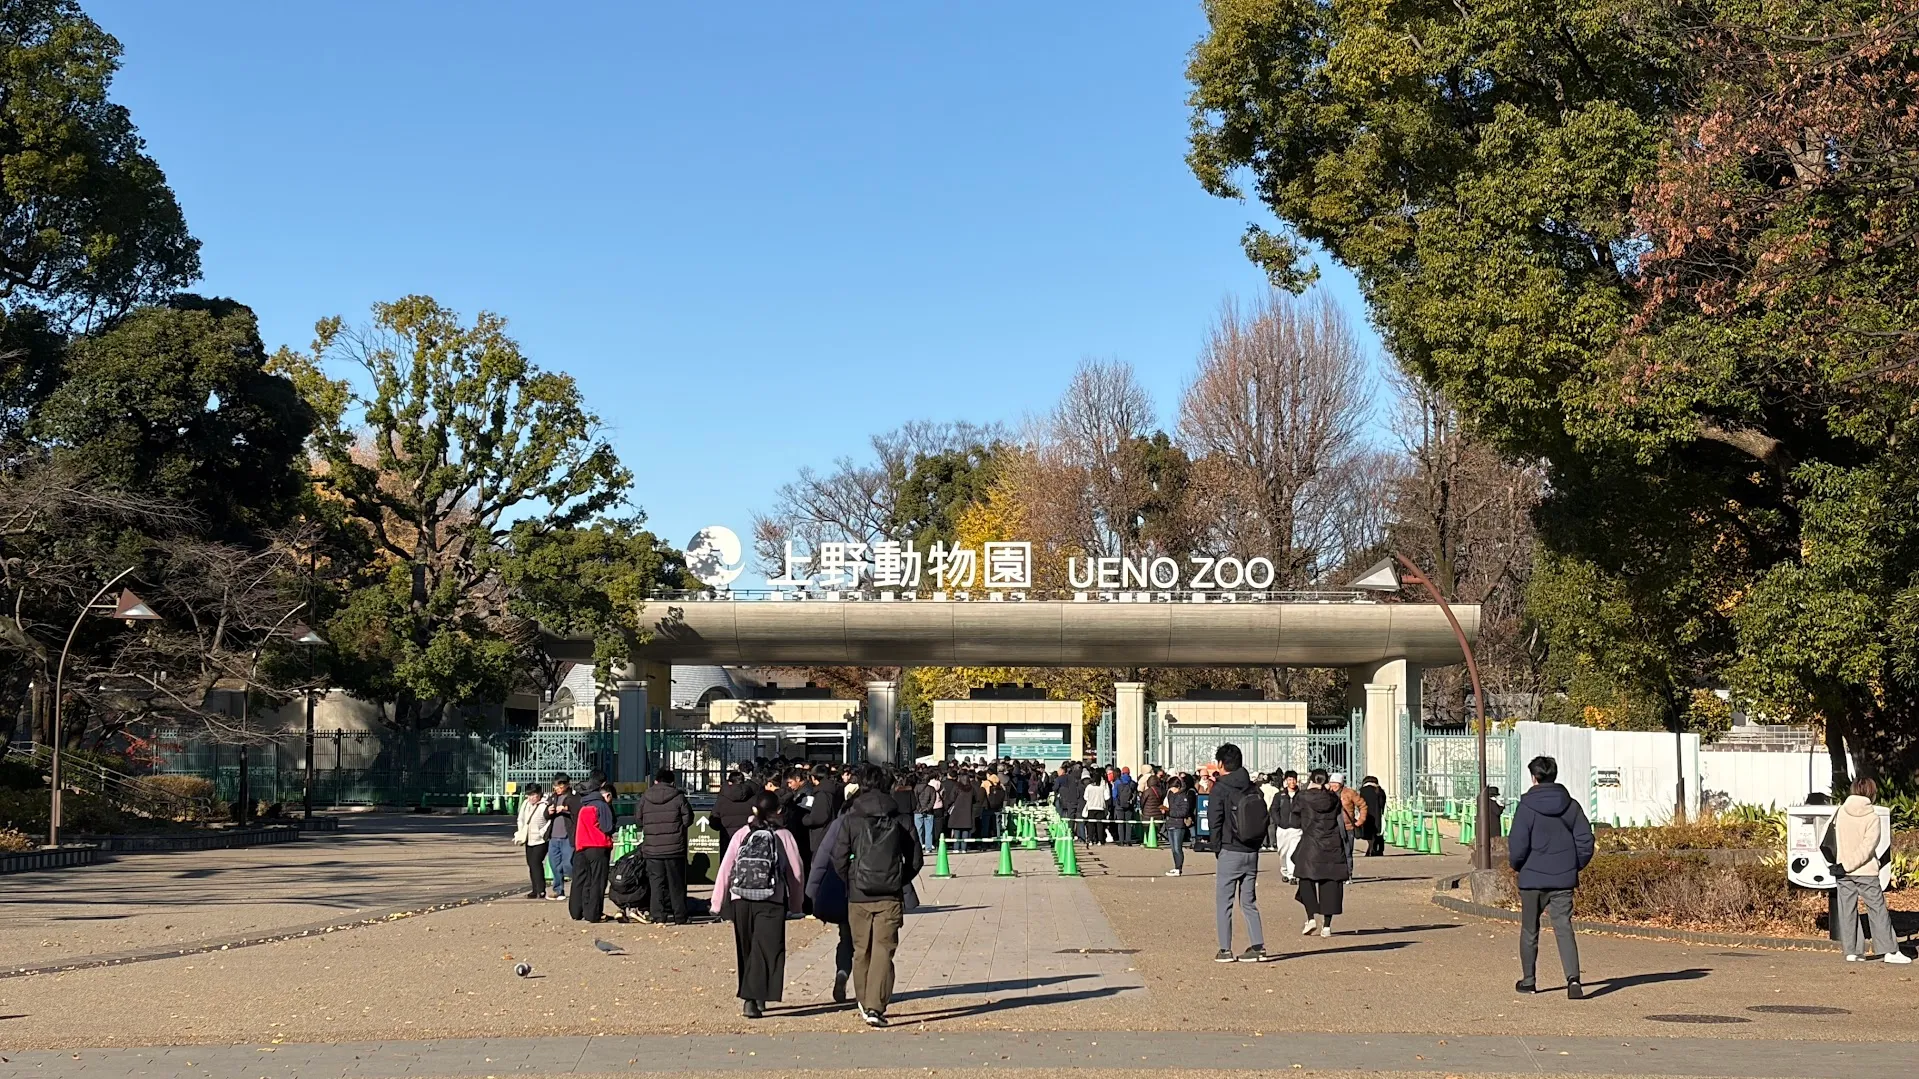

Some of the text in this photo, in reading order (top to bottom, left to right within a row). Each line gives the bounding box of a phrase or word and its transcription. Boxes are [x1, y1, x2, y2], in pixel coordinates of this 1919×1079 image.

[766, 539, 1031, 588] 上野動物園
[1069, 557, 1275, 589] UENO ZOO
